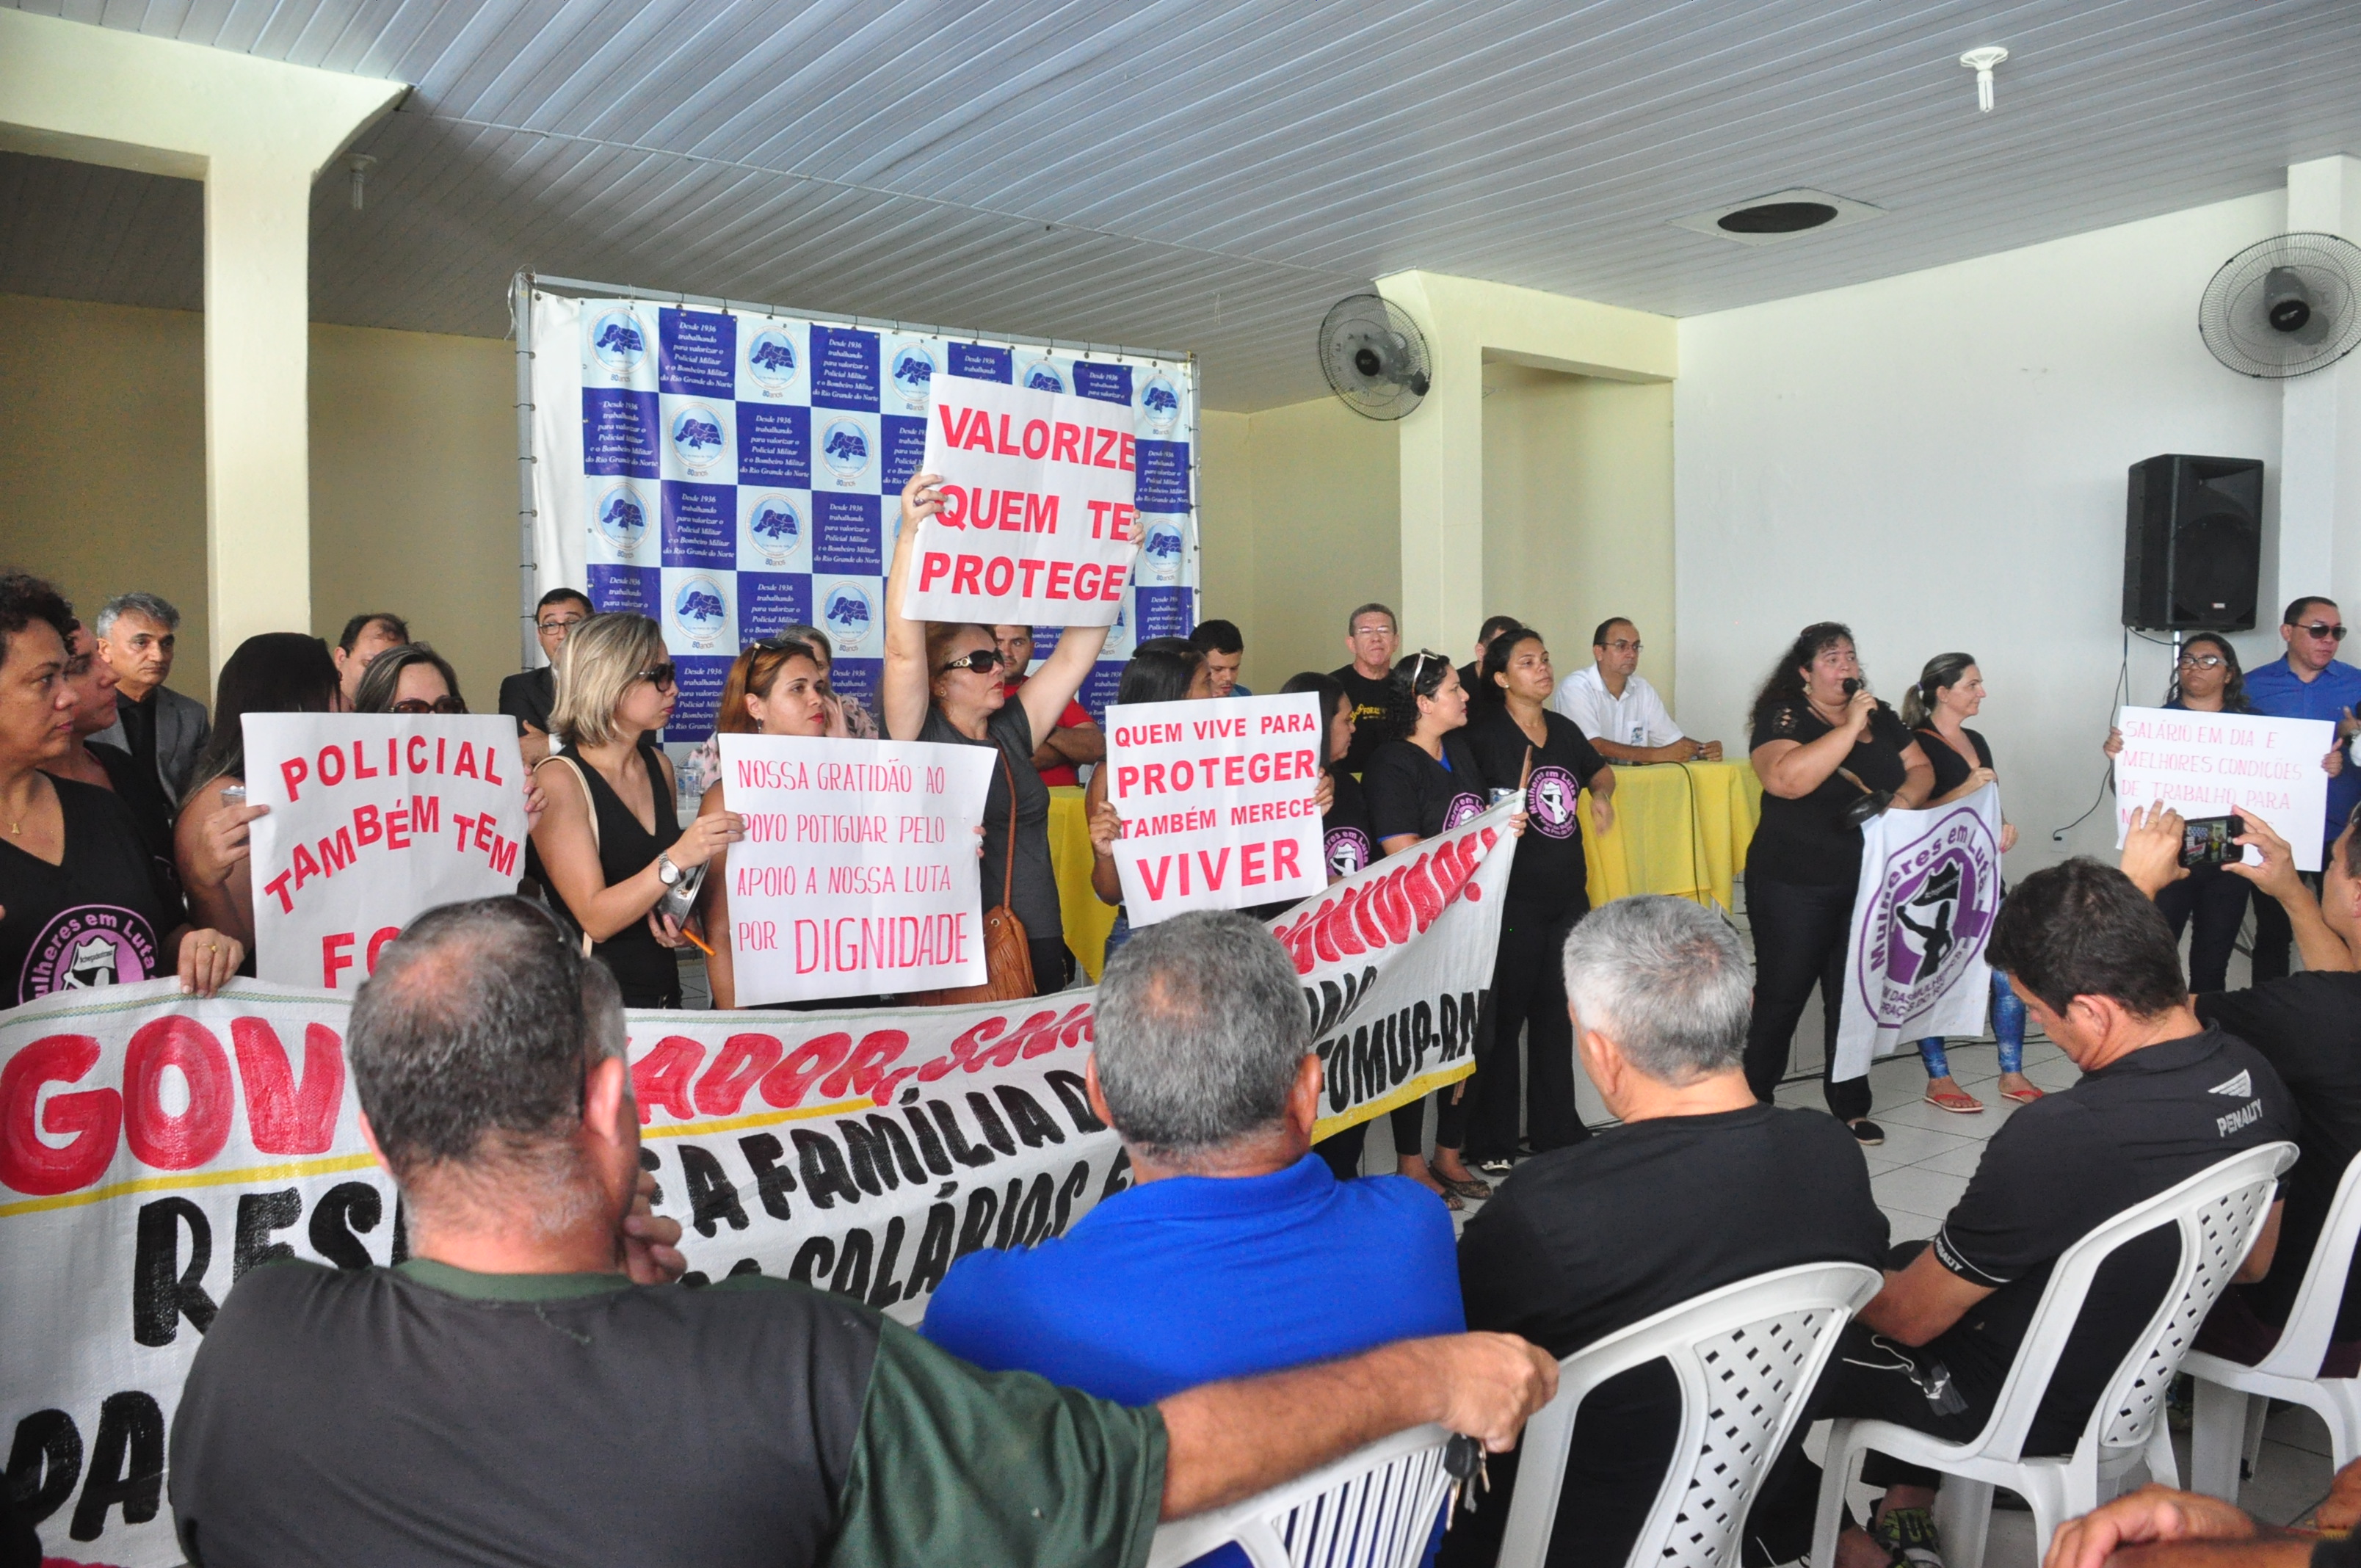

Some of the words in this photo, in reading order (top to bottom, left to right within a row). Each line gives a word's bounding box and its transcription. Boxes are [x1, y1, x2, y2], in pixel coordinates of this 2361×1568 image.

[678, 334, 717, 343] trabalhando
[679, 322, 699, 330] Desde
[675, 354, 697, 363] Policial
[699, 357, 721, 365] Militar
[689, 346, 718, 354] valorizar
[678, 365, 706, 374] Bombeiro
[707, 369, 728, 377] Militar
[683, 376, 706, 385] Grande
[938, 404, 1135, 472] VALORIZE
[755, 457, 783, 465] Bombeiro
[682, 493, 699, 501] Desde
[682, 505, 717, 513] trabalhando
[934, 484, 1059, 534] QUEM
[1087, 499, 1135, 542] TE
[680, 537, 707, 545] Bombeiro
[686, 548, 707, 556] Grande
[918, 551, 1127, 601] PROTEGE
[1115, 722, 1182, 748] QUEM
[1193, 717, 1247, 740] VIVE
[1261, 713, 1316, 736] PARA
[2126, 719, 2191, 742] SALÁRIO
[2198, 727, 2222, 744] EM
[2230, 729, 2253, 746] DIA
[2266, 732, 2278, 749] E
[280, 735, 504, 802] POLICIAL
[738, 760, 808, 790] NOSSA
[817, 758, 912, 793] GRATIDÃO
[926, 766, 945, 794] AO
[1117, 749, 1316, 799] PROTEGER
[2122, 750, 2213, 773] MELHORES
[2219, 757, 2302, 780] CONDIÇÕES
[1476, 799, 1484, 812] Lu
[1527, 772, 1544, 814] Mulheres
[1561, 773, 1576, 796] Luta
[2122, 780, 2139, 797] DE
[2153, 782, 2236, 805] TRABALHO
[2246, 790, 2290, 810] PARA
[740, 813, 787, 842] POVO
[797, 815, 888, 843] POTIGUAR
[899, 816, 945, 843] PELO
[1123, 806, 1216, 840] TAMBÉM
[1230, 797, 1314, 826] MERECE
[264, 795, 440, 915] TAMBÉM
[453, 812, 518, 877] TEM
[1358, 837, 1368, 863] Luta
[1948, 825, 1968, 844] em
[1968, 829, 1990, 893] Luta
[737, 866, 796, 897] APOIO
[805, 866, 816, 894] A
[827, 866, 896, 894] NOSSA
[904, 865, 951, 893] LUTA
[1136, 838, 1302, 902] VIVER
[31, 919, 81, 998] ulheres
[85, 913, 117, 928] em
[123, 920, 156, 969] Luta
[738, 921, 777, 951] POR
[794, 912, 968, 975] DIGNIDADE
[2216, 1098, 2263, 1137] PENALTY
[678, 1144, 750, 1238] A
[738, 1087, 1066, 1222] FAMÍLIA
